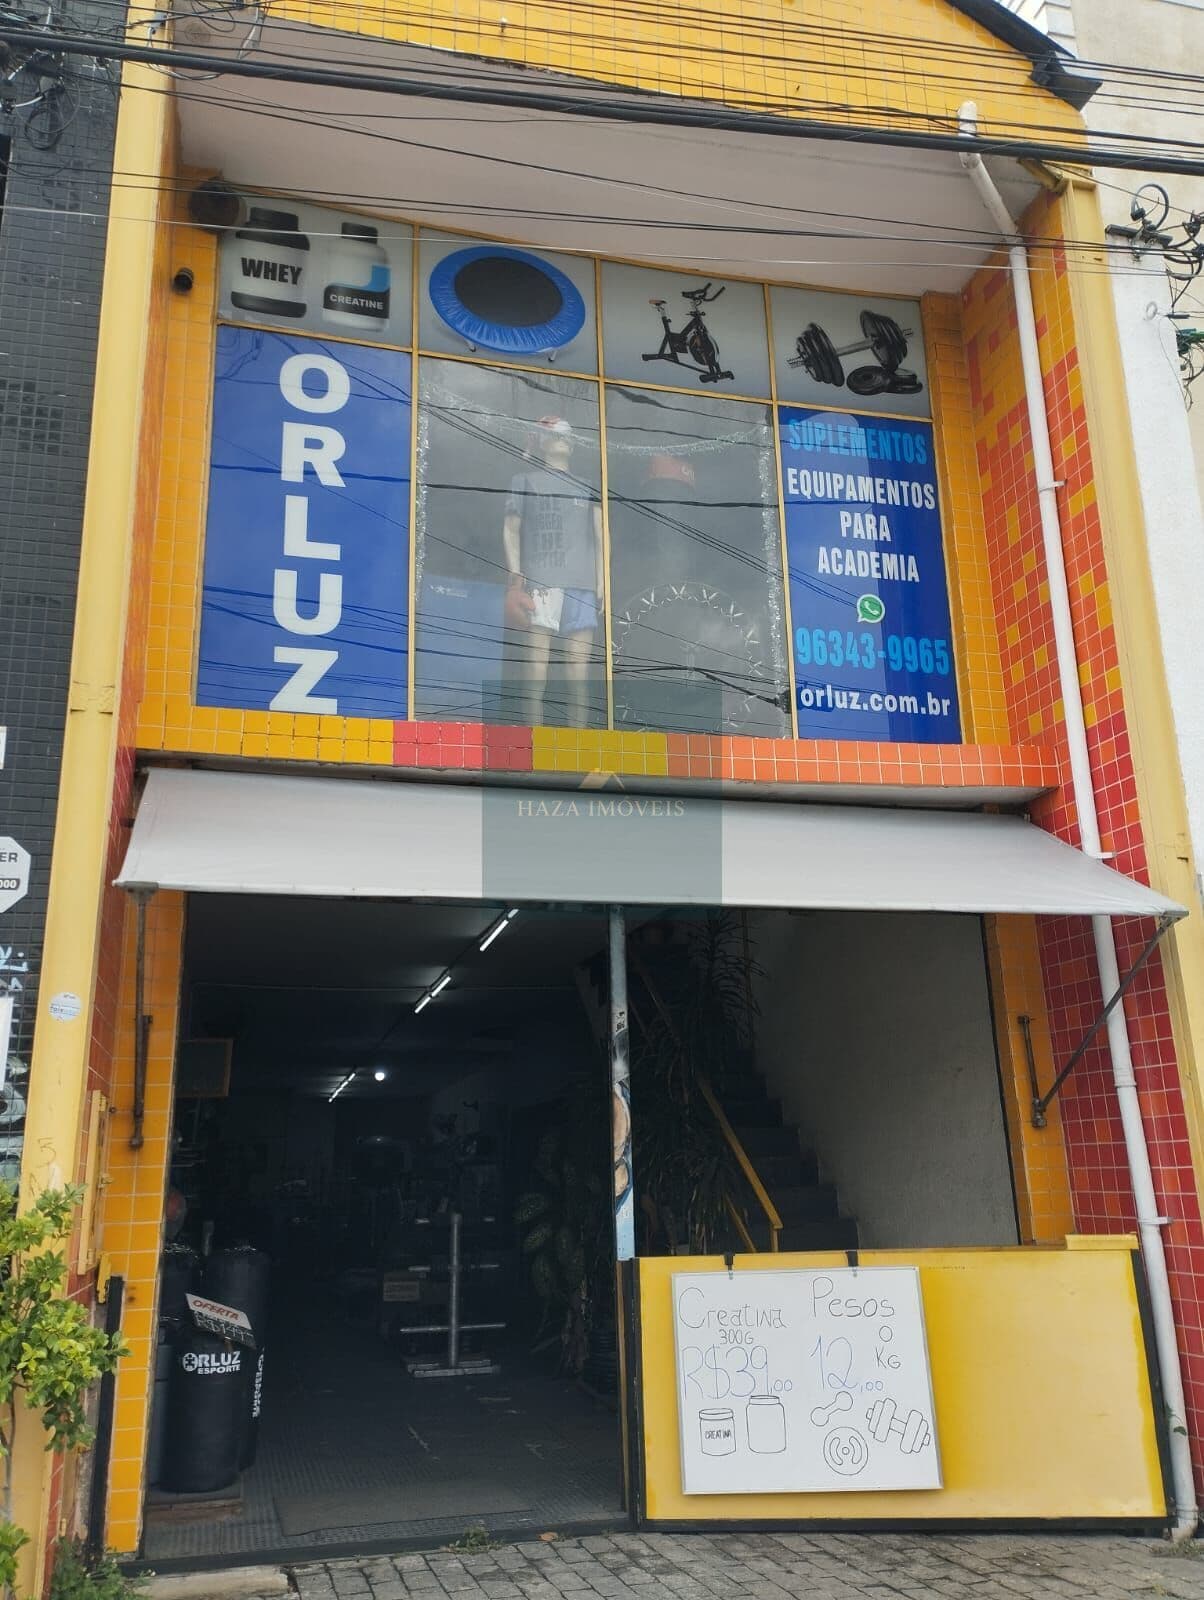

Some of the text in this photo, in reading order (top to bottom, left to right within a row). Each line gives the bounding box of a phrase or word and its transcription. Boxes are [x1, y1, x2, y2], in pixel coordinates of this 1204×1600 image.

[241, 257, 303, 286] WHEY
[329, 293, 384, 310] CREATINE
[788, 419, 927, 465] SUPLEMENTOS
[787, 467, 935, 510] EQUIPAMENTOS
[269, 353, 350, 714] ORLUZ
[840, 510, 892, 542] PARA
[818, 546, 920, 583] ACADEMIA
[796, 627, 949, 675] 96343-9965
[800, 684, 950, 716] orluz.com.br
[192, 1299, 240, 1321] OFERTA
[812, 1276, 896, 1318] Pesos
[718, 1329, 754, 1345] 300G
[197, 1363, 241, 1375] ESPORTE
